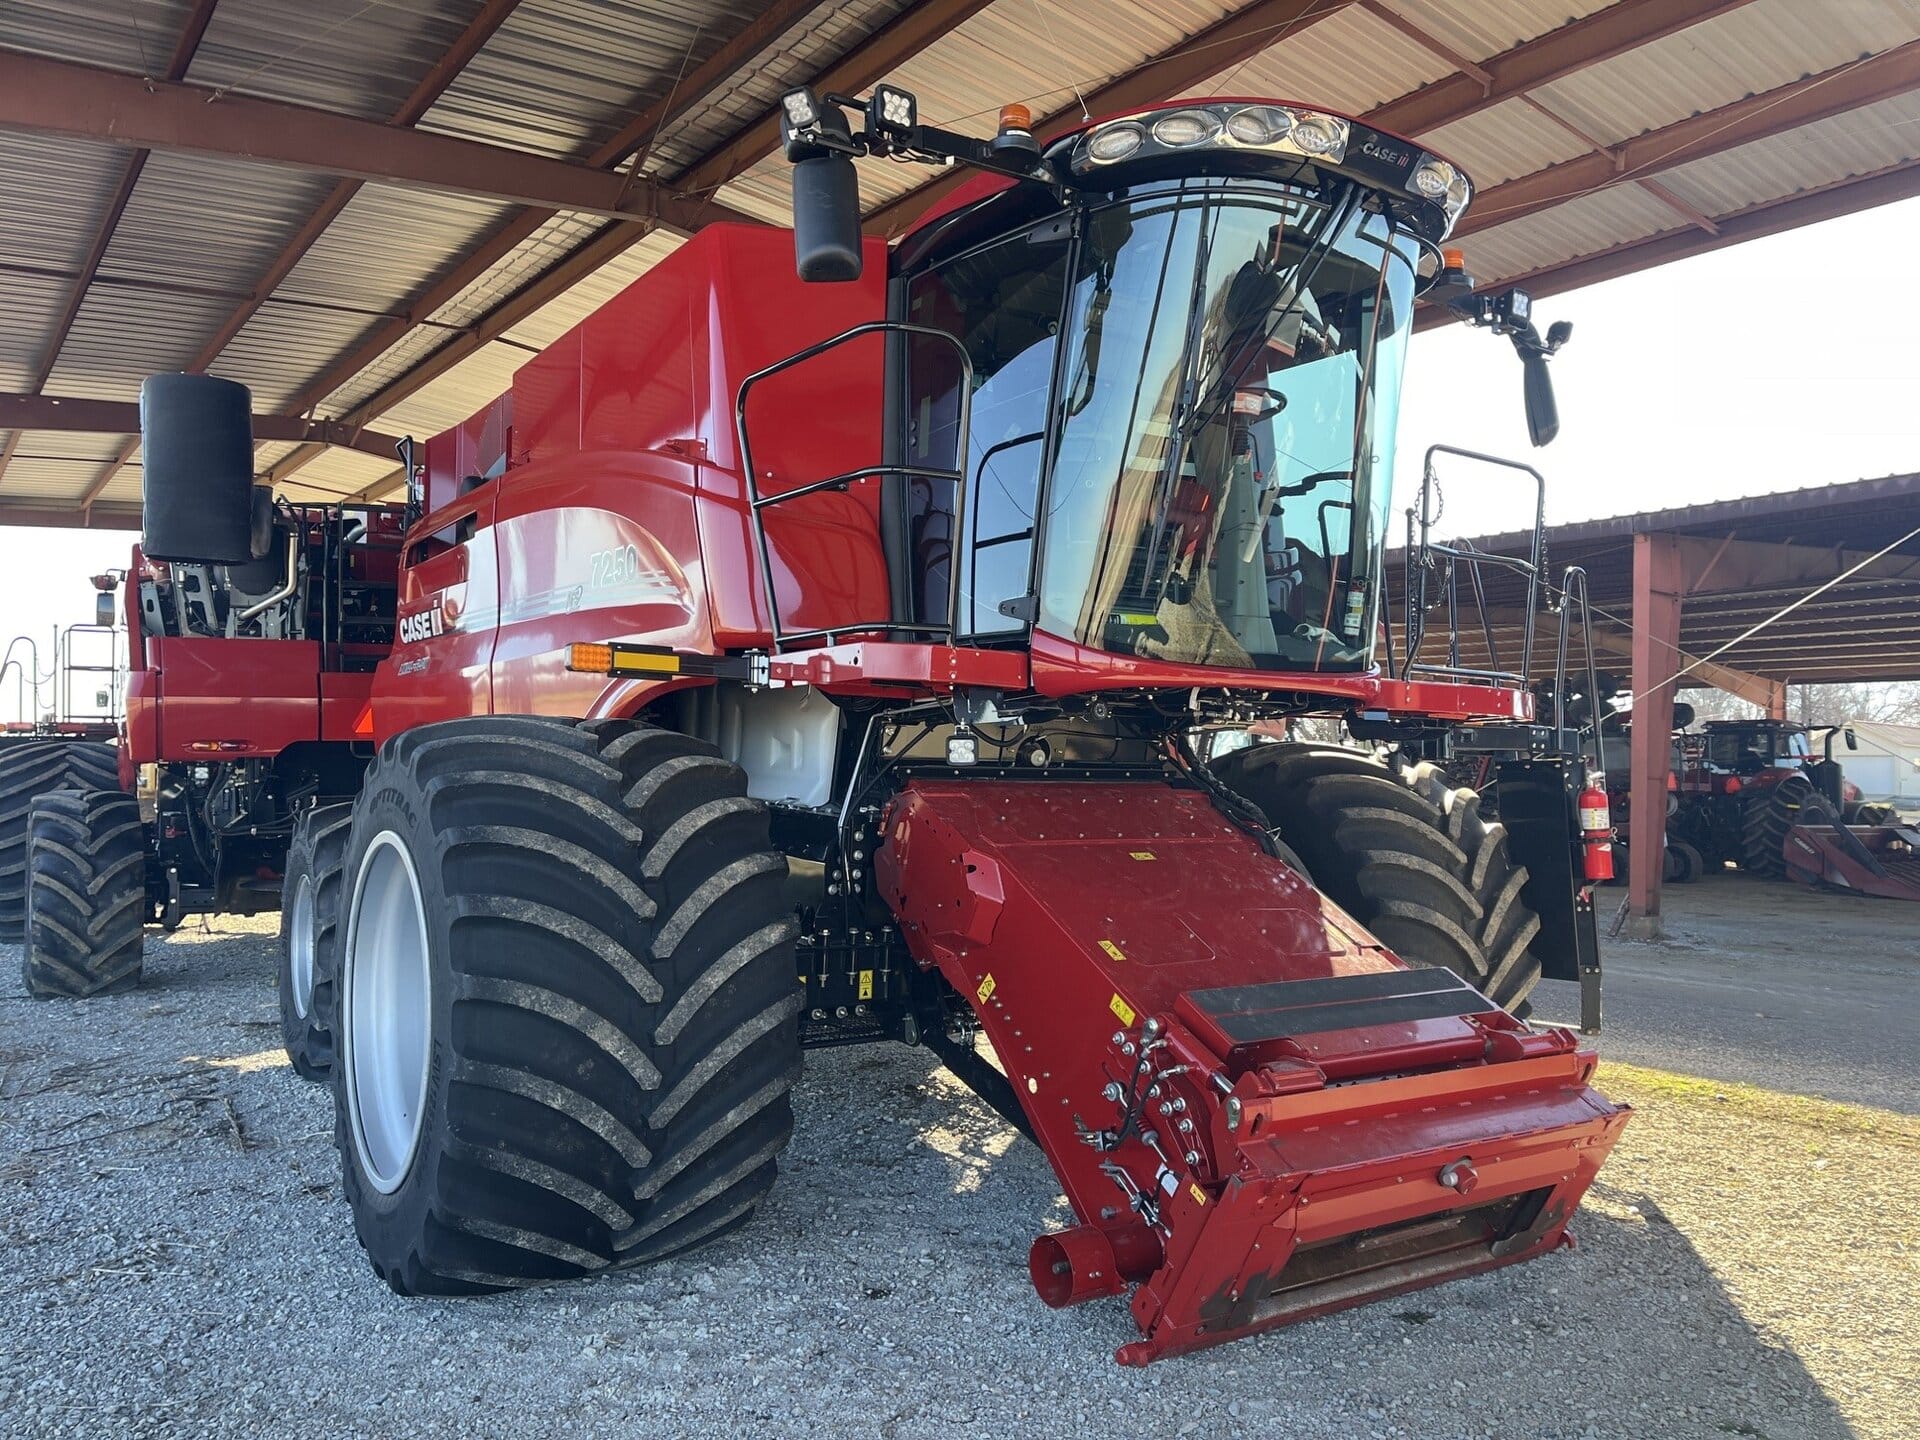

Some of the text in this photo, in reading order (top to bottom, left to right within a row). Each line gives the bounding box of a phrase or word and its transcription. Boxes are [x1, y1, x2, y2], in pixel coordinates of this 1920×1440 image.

[1363, 142, 1397, 163] CASE
[591, 543, 639, 590] 7250
[400, 611, 431, 644] CASE
